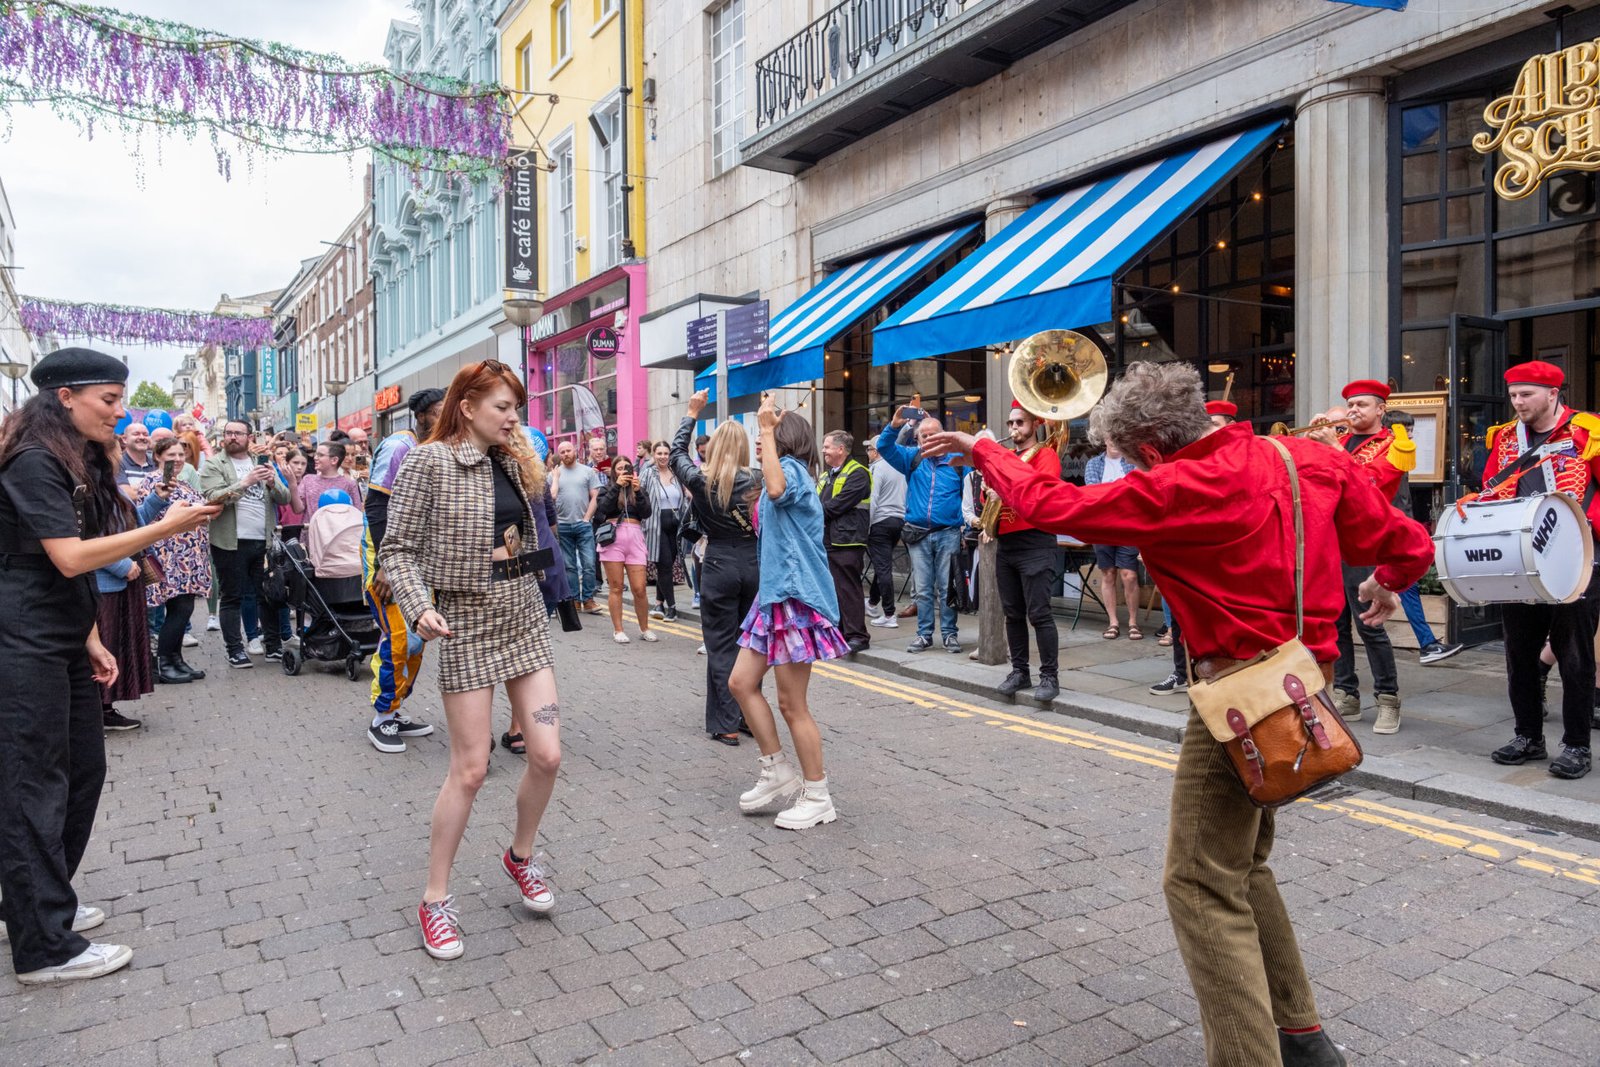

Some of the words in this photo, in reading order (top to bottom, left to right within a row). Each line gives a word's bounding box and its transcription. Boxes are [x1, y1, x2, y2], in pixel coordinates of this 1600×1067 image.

[1472, 37, 1600, 154] ALB
[513, 156, 530, 211] latino
[513, 219, 531, 258] café
[531, 312, 554, 343] DUMAN
[592, 339, 615, 348] DUMAN
[1532, 507, 1558, 554] WHD
[1464, 548, 1503, 562] WHD
